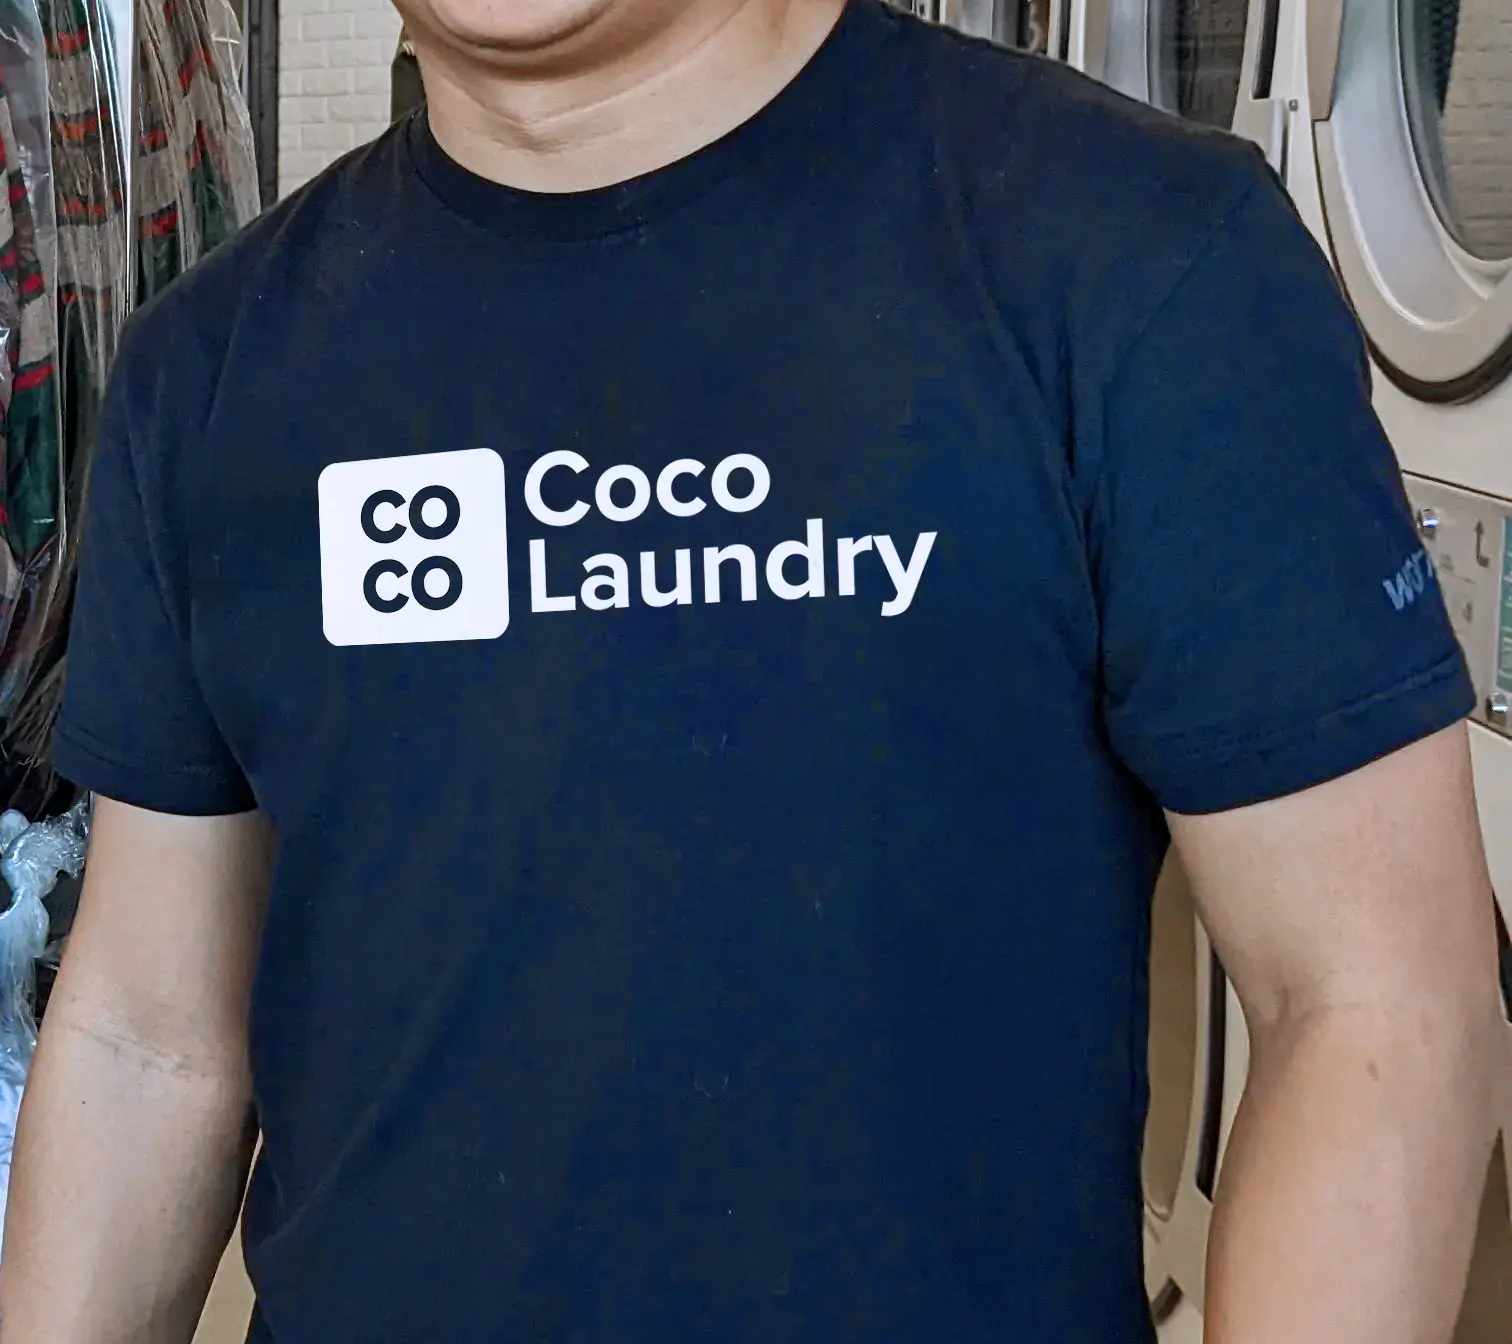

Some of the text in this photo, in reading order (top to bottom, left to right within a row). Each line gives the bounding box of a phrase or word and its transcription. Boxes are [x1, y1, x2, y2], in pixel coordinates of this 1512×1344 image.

[360, 484, 461, 544] CO
[523, 449, 772, 527] Coco
[363, 555, 464, 613] CO
[528, 517, 938, 617] Laundry
